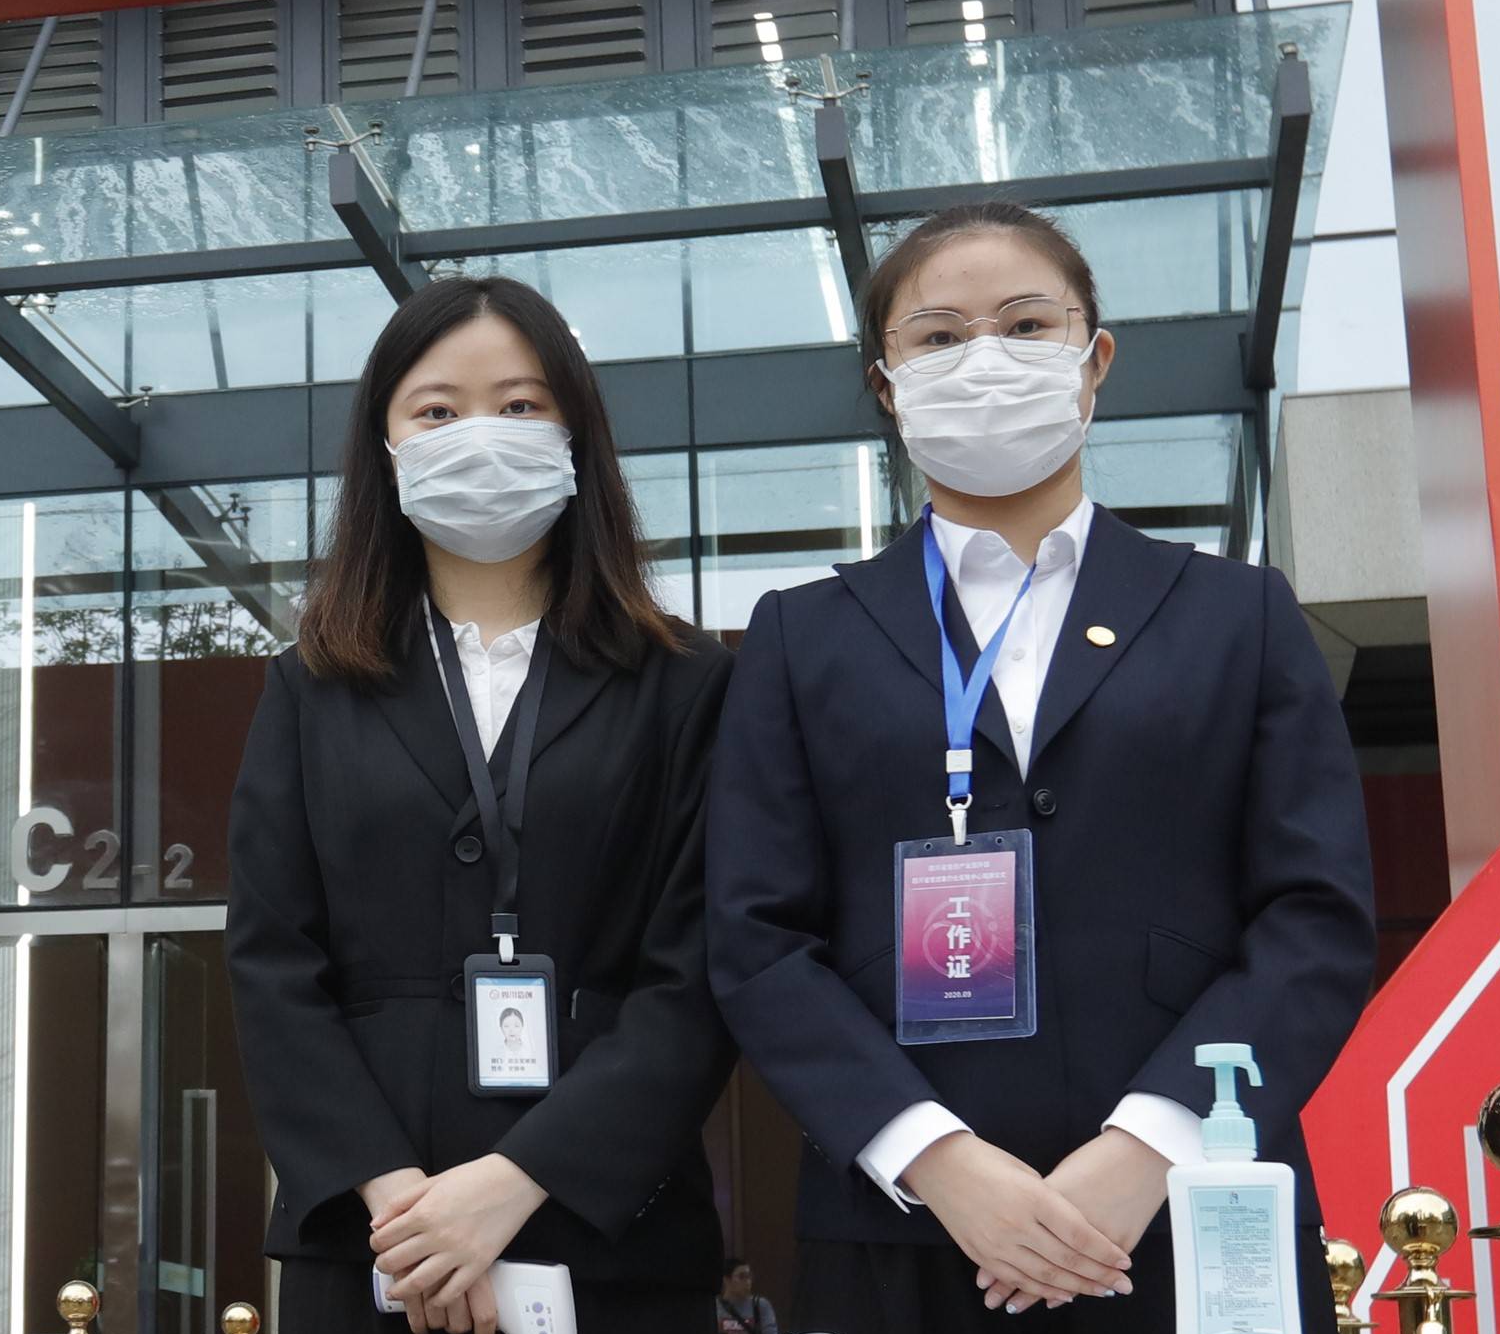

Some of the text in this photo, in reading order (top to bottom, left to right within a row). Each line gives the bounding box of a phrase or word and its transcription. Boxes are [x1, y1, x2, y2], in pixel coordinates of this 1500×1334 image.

[11, 806, 194, 893] C2-2
[946, 895, 972, 979] 工作证
